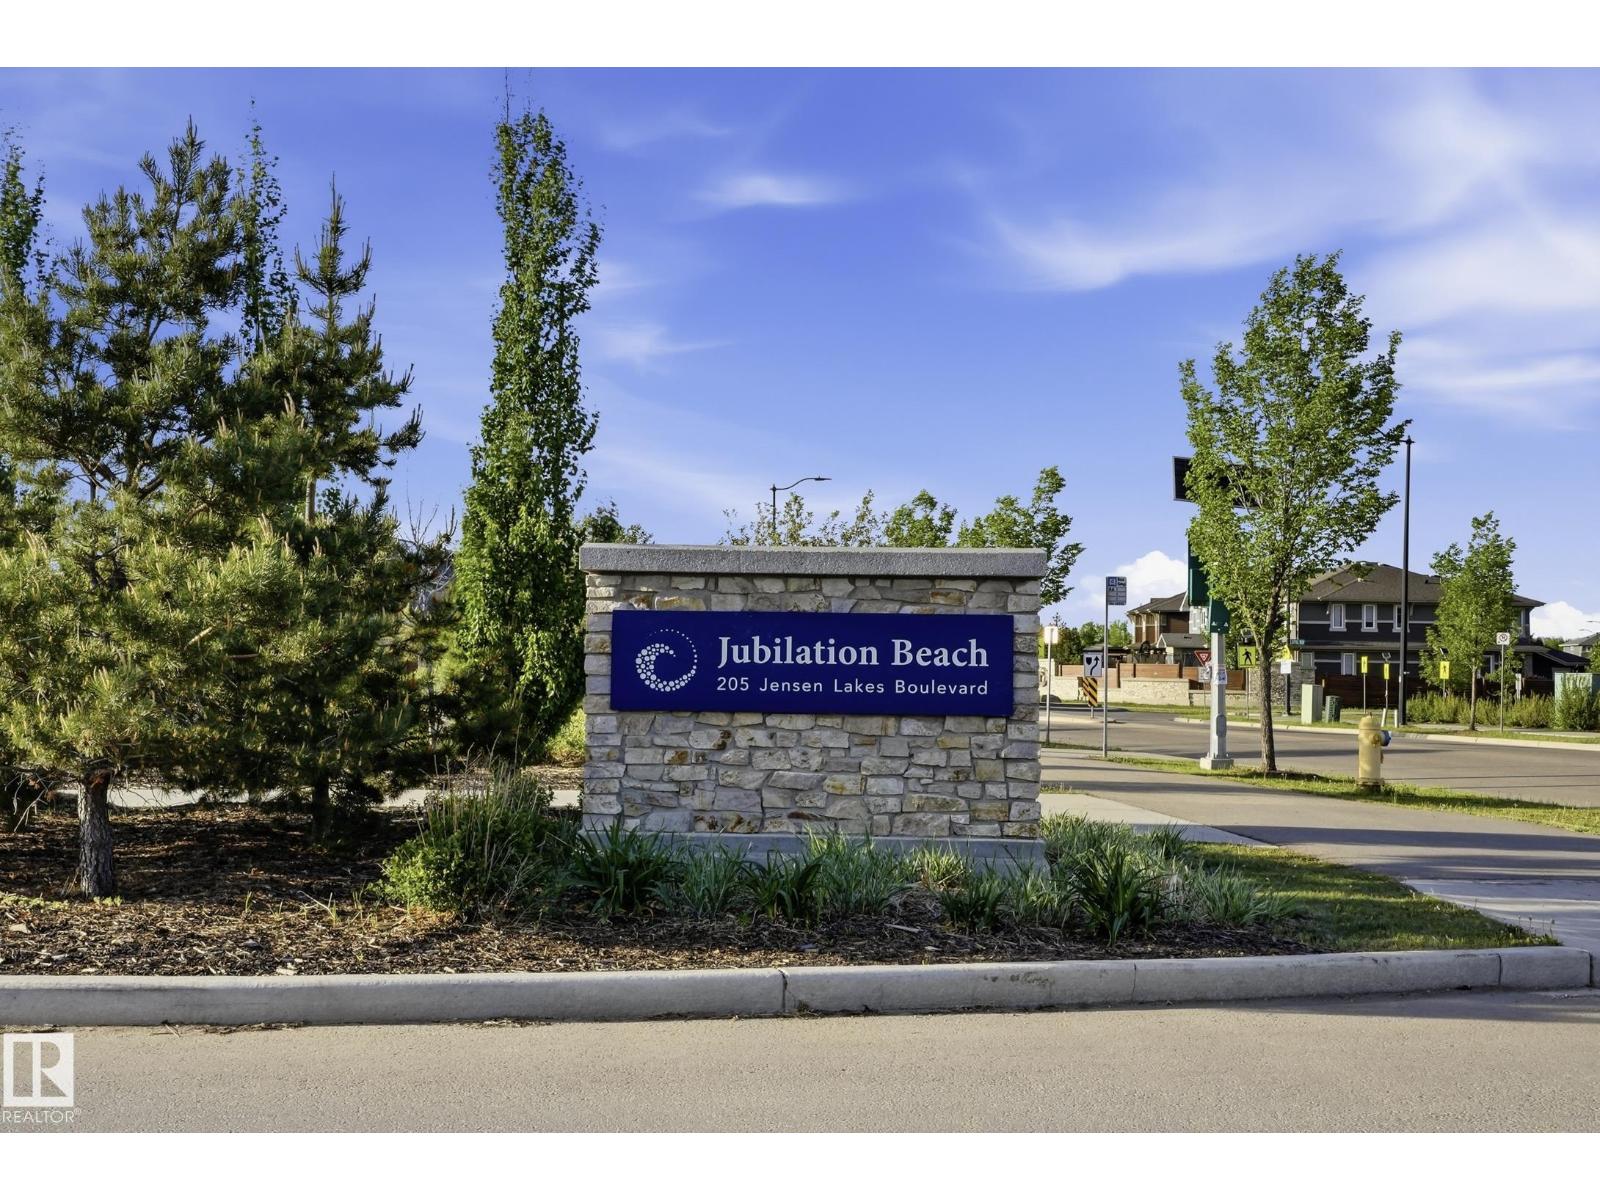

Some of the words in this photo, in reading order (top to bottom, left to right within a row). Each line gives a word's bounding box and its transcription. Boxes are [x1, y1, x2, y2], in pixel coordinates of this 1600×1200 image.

[717, 635, 880, 669] Jubilation
[890, 638, 990, 667] Beach
[716, 676, 749, 691] 205
[759, 677, 823, 692] Jensen
[834, 678, 885, 694] Lakes
[895, 679, 988, 695] Boulevard
